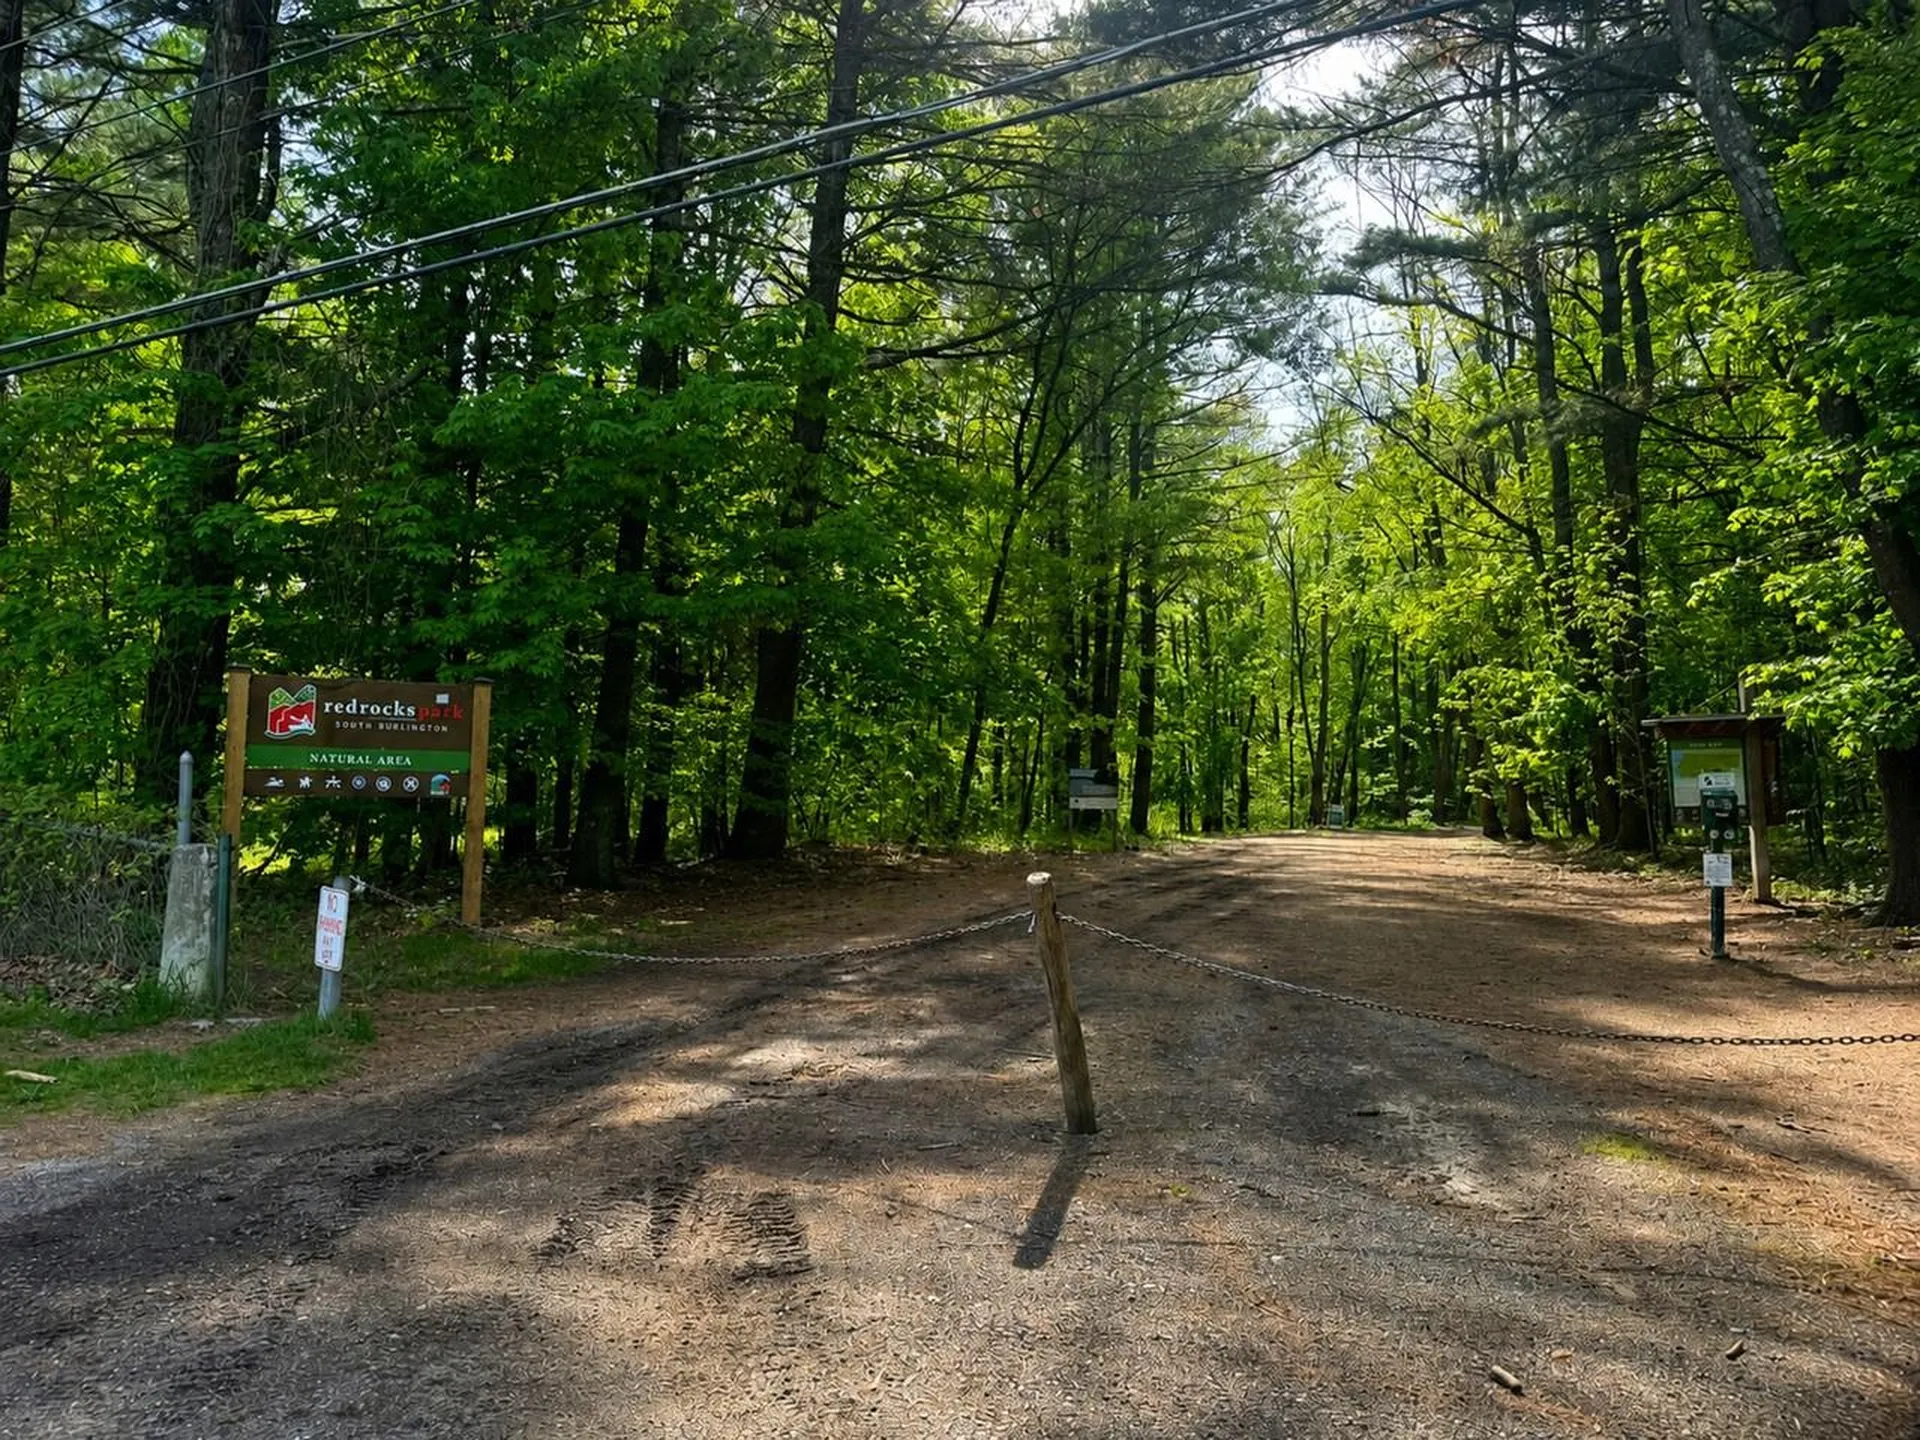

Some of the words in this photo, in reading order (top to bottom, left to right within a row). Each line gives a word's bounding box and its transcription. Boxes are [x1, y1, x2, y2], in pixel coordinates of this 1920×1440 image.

[335, 721, 373, 730] SOUTH
[379, 722, 448, 732] BURLINGTON
[309, 753, 373, 765] NATURAL
[377, 755, 412, 766] AREA
